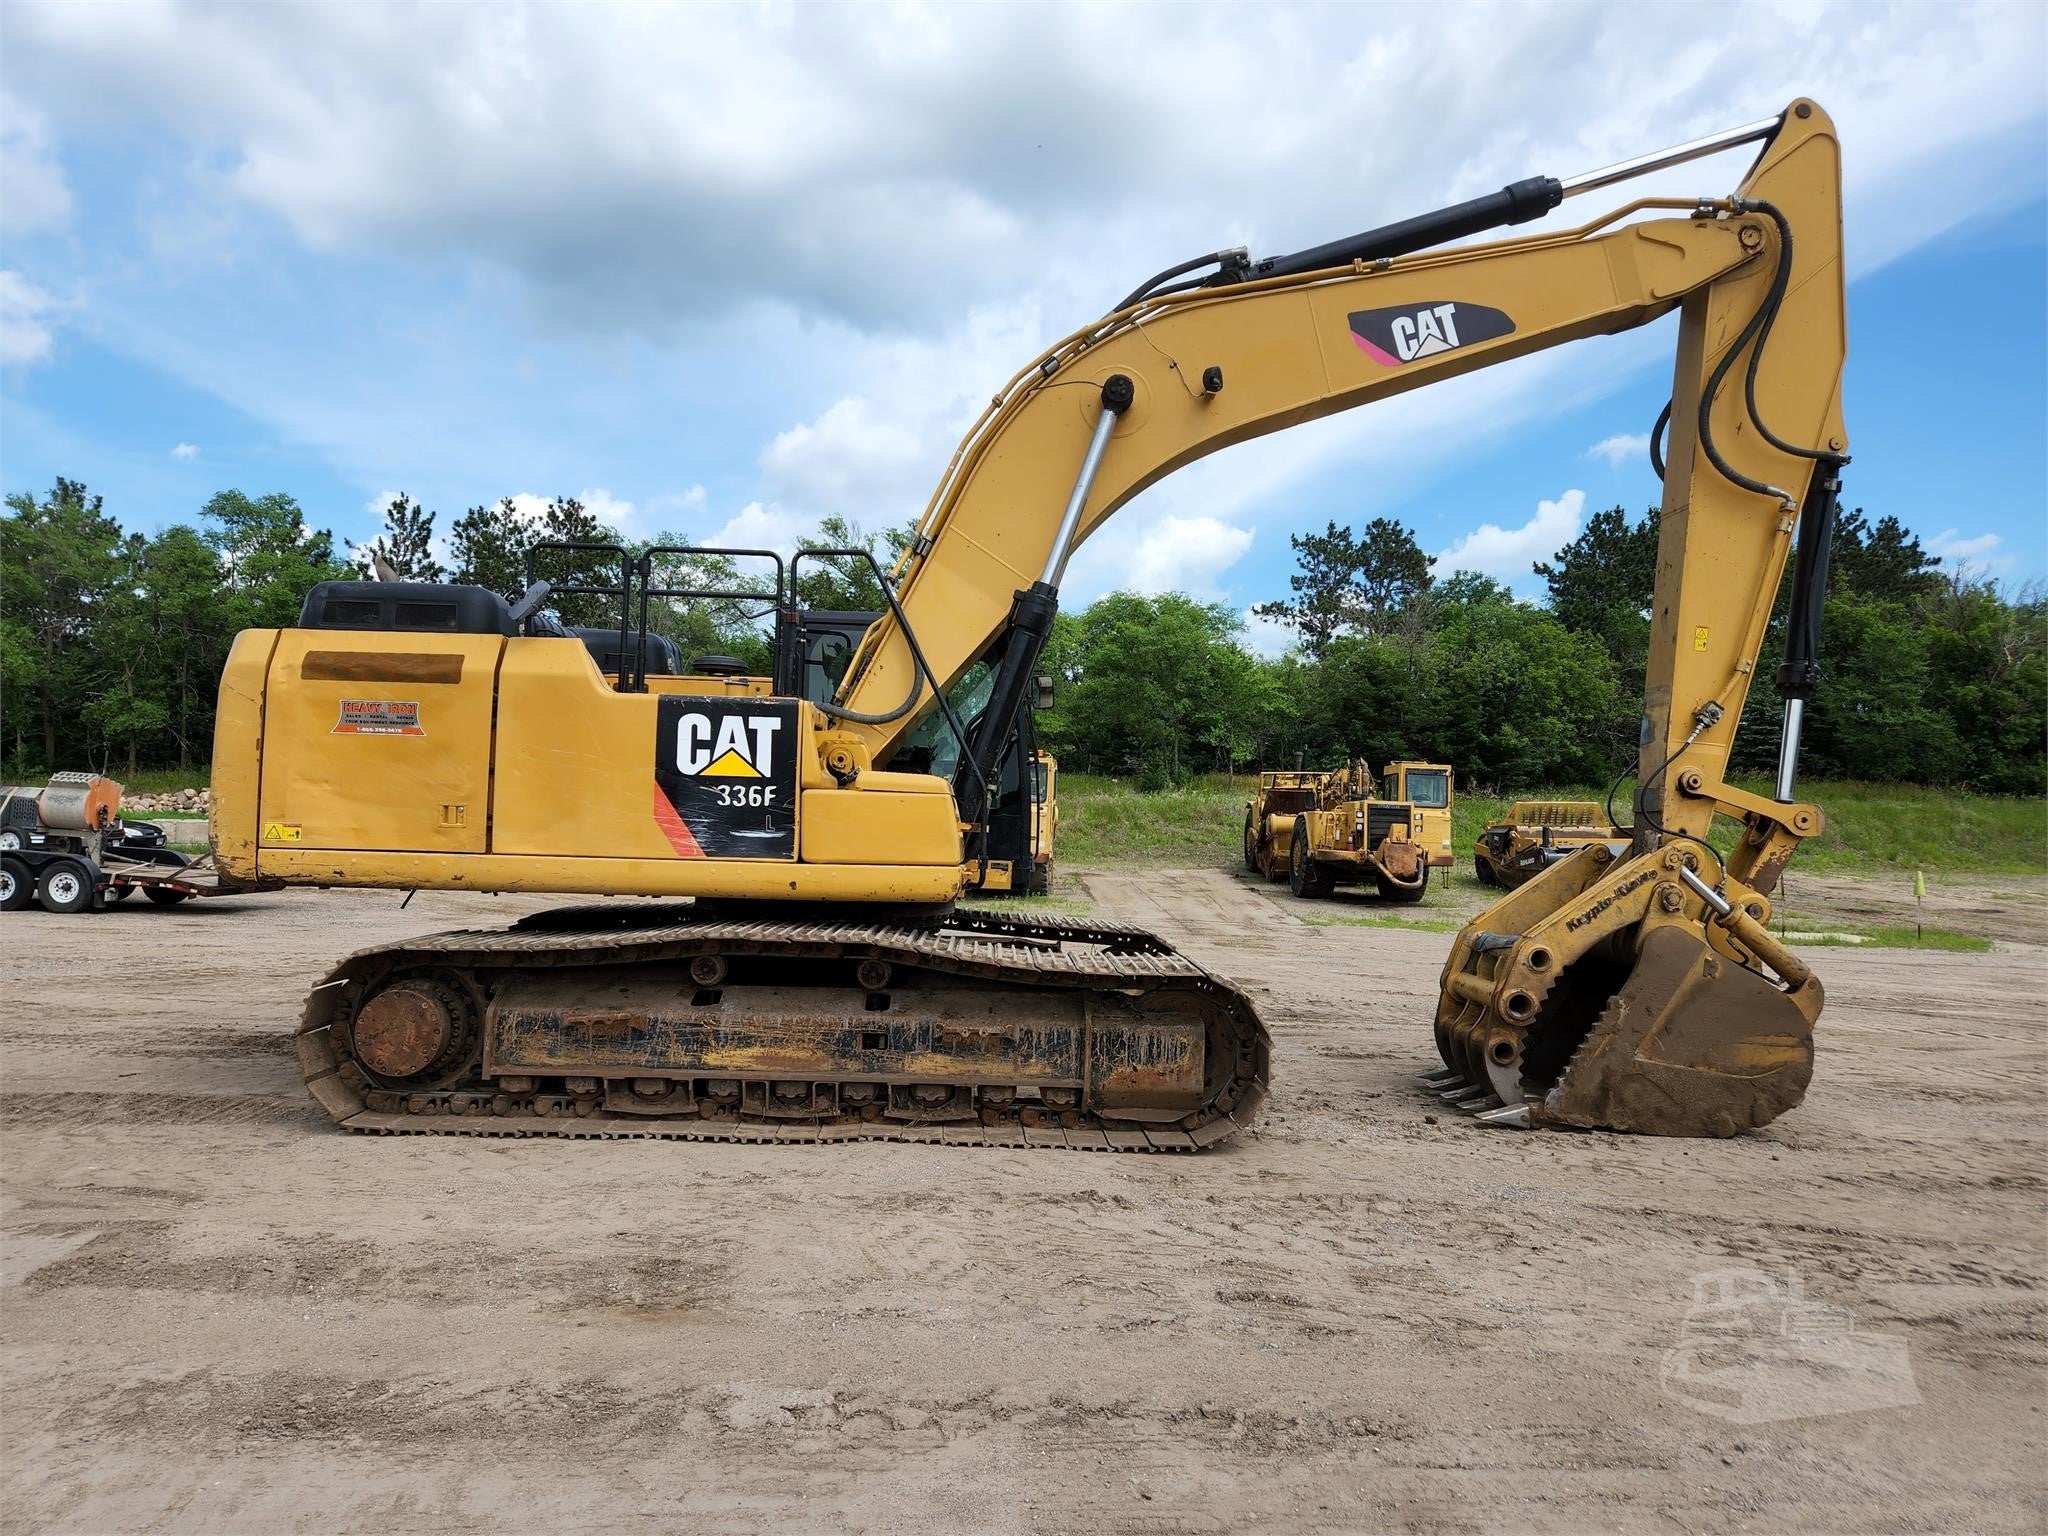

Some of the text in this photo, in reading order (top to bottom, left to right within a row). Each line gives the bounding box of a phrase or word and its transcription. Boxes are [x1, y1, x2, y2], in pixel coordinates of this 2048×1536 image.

[1391, 303, 1460, 361] CAT
[343, 702, 417, 714] HEAVY IRON
[676, 713, 782, 778] CAT
[716, 785, 777, 807] 336F
